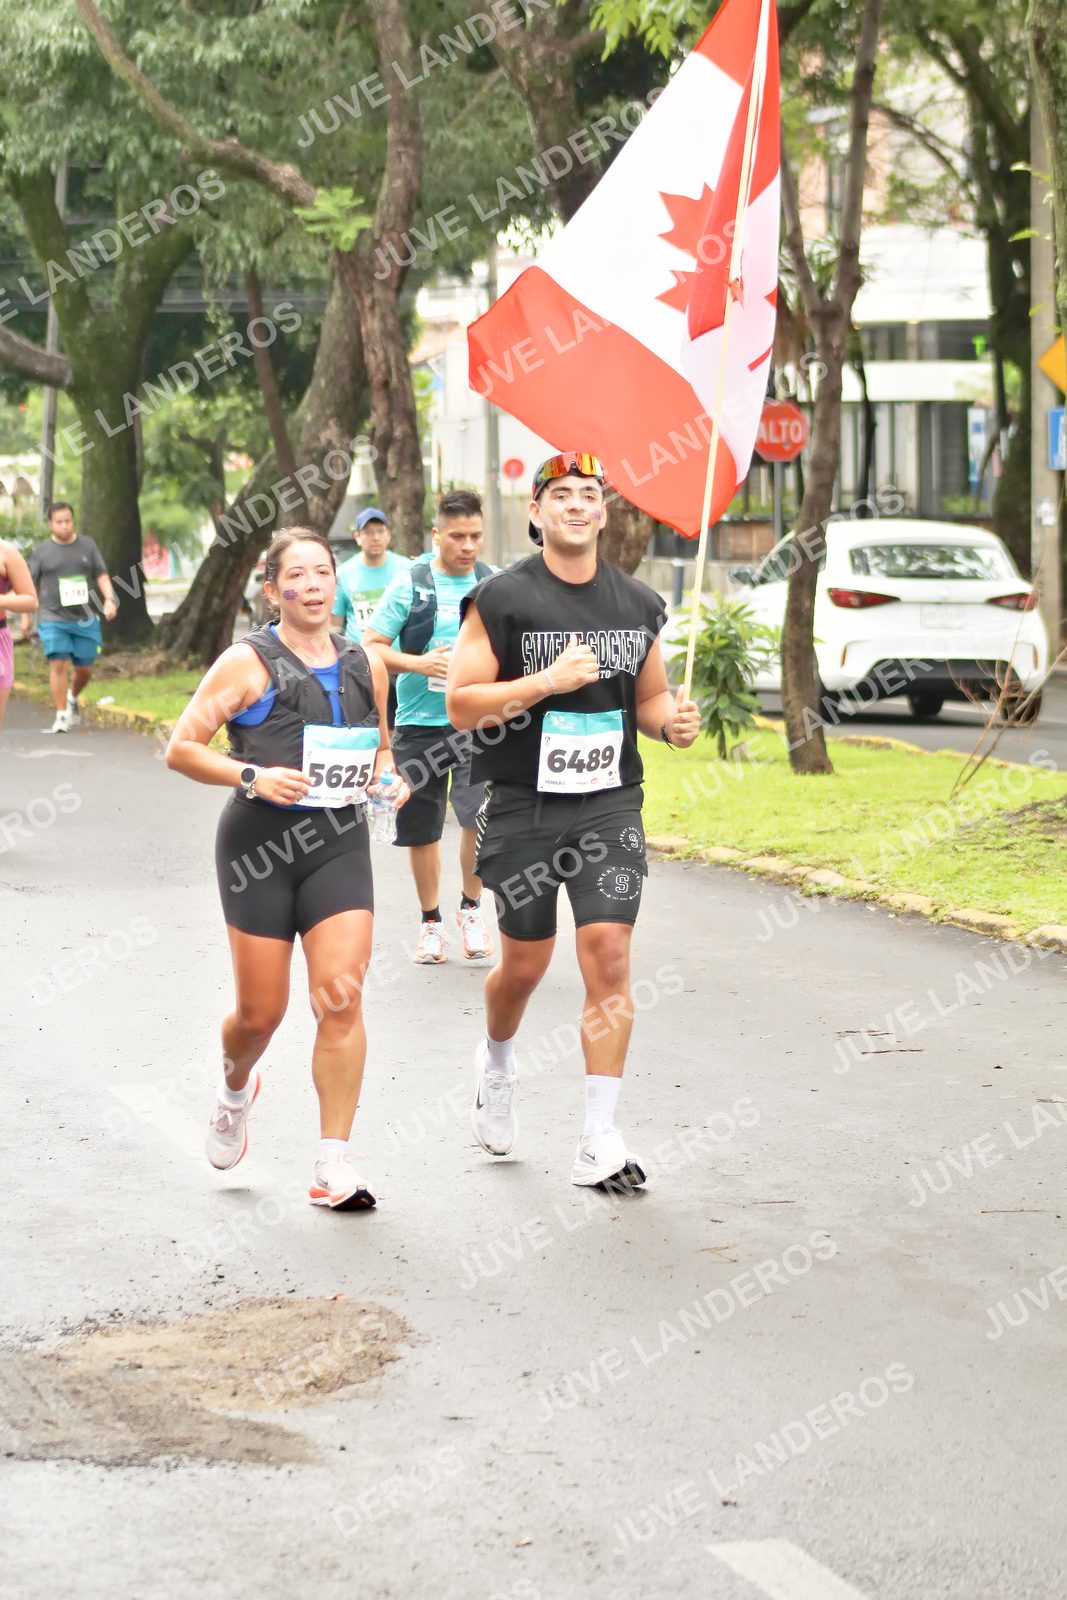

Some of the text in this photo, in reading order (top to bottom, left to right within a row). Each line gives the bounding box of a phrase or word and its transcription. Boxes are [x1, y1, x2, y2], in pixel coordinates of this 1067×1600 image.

[758, 418, 803, 444] ALTO
[522, 632, 584, 676] SWE
[547, 745, 614, 774] 6489
[308, 763, 371, 789] 5625
[597, 867, 616, 886] SWEAT
[615, 874, 629, 894] S
